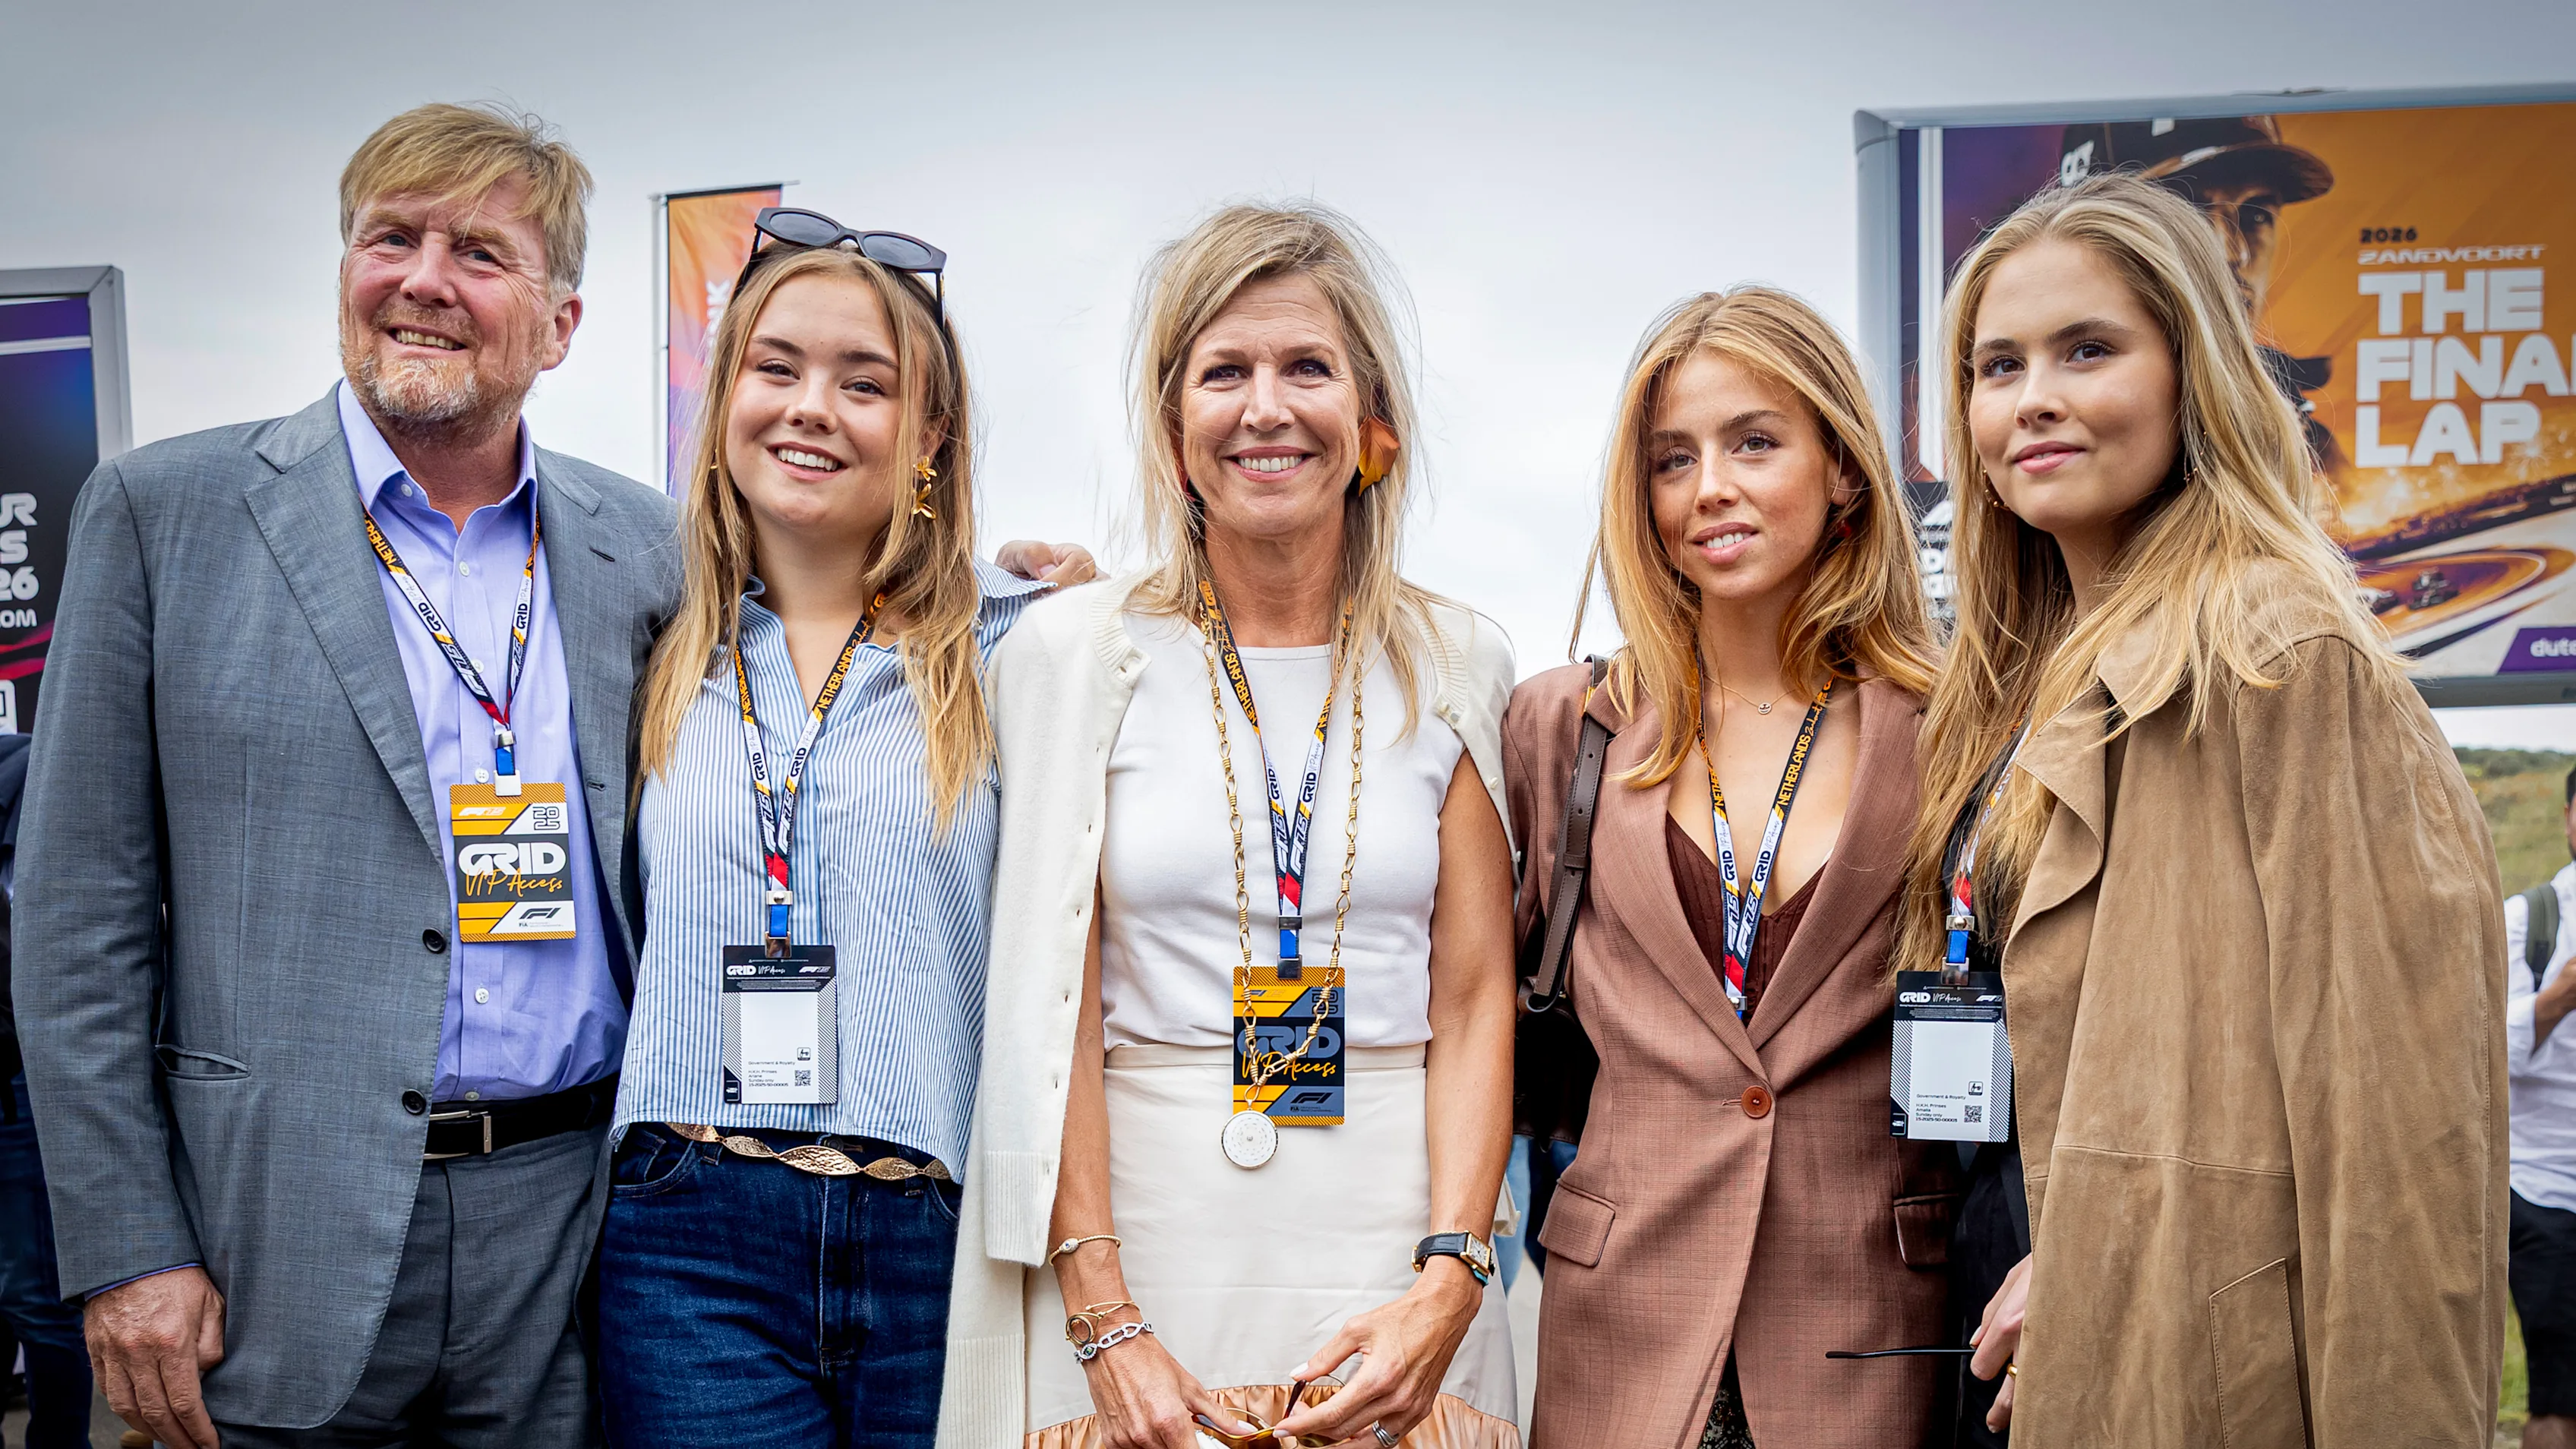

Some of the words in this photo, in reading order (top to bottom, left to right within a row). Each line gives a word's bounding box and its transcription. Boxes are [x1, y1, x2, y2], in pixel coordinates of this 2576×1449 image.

[2360, 227, 2418, 244] 2026
[2357, 243, 2547, 265] ZANDVOORT
[2357, 267, 2544, 336] THE
[2356, 333, 2576, 402] FINA
[2355, 400, 2541, 469] LAP
[418, 602, 442, 632] GRID
[516, 603, 528, 630] GRID
[790, 747, 807, 778] GRID
[816, 646, 855, 709] NETHERLANDS
[753, 753, 766, 781] GRID
[1268, 769, 1280, 800] GRID
[1302, 772, 1316, 803] GRID
[1754, 851, 1771, 882] GRID
[1777, 734, 1812, 806] NETHERLANDS
[458, 842, 567, 876] GRID
[1722, 850, 1735, 881] GRID
[466, 868, 508, 897] VIP
[507, 867, 563, 898] Access
[519, 908, 562, 920] F1
[726, 964, 757, 976] GRID
[1899, 991, 1931, 1003] GRID
[1237, 1026, 1341, 1059] GRID
[1283, 1059, 1337, 1081] Access
[1290, 1092, 1334, 1103] F1
